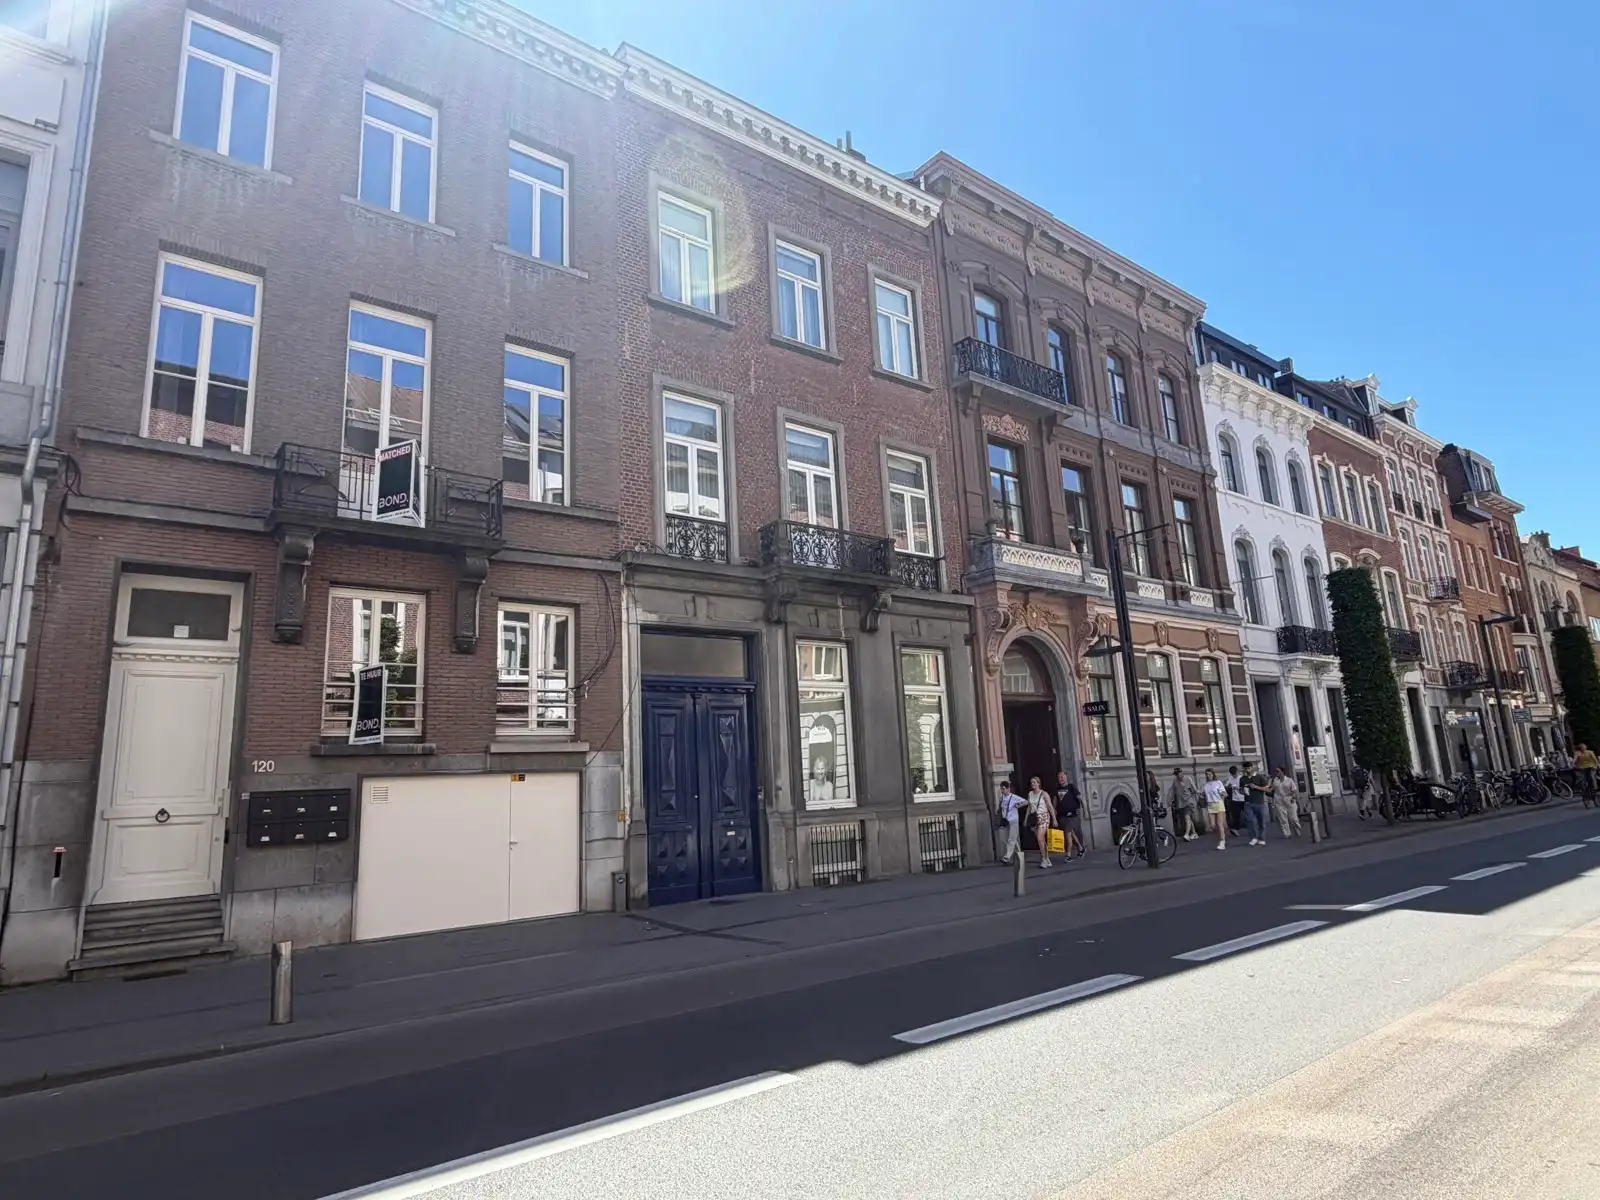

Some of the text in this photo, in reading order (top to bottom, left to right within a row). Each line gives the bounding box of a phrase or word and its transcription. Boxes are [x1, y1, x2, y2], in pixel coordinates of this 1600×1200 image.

[378, 445, 411, 462] MATCHED
[361, 669, 382, 681] TE HUUR
[251, 760, 275, 773] 120
